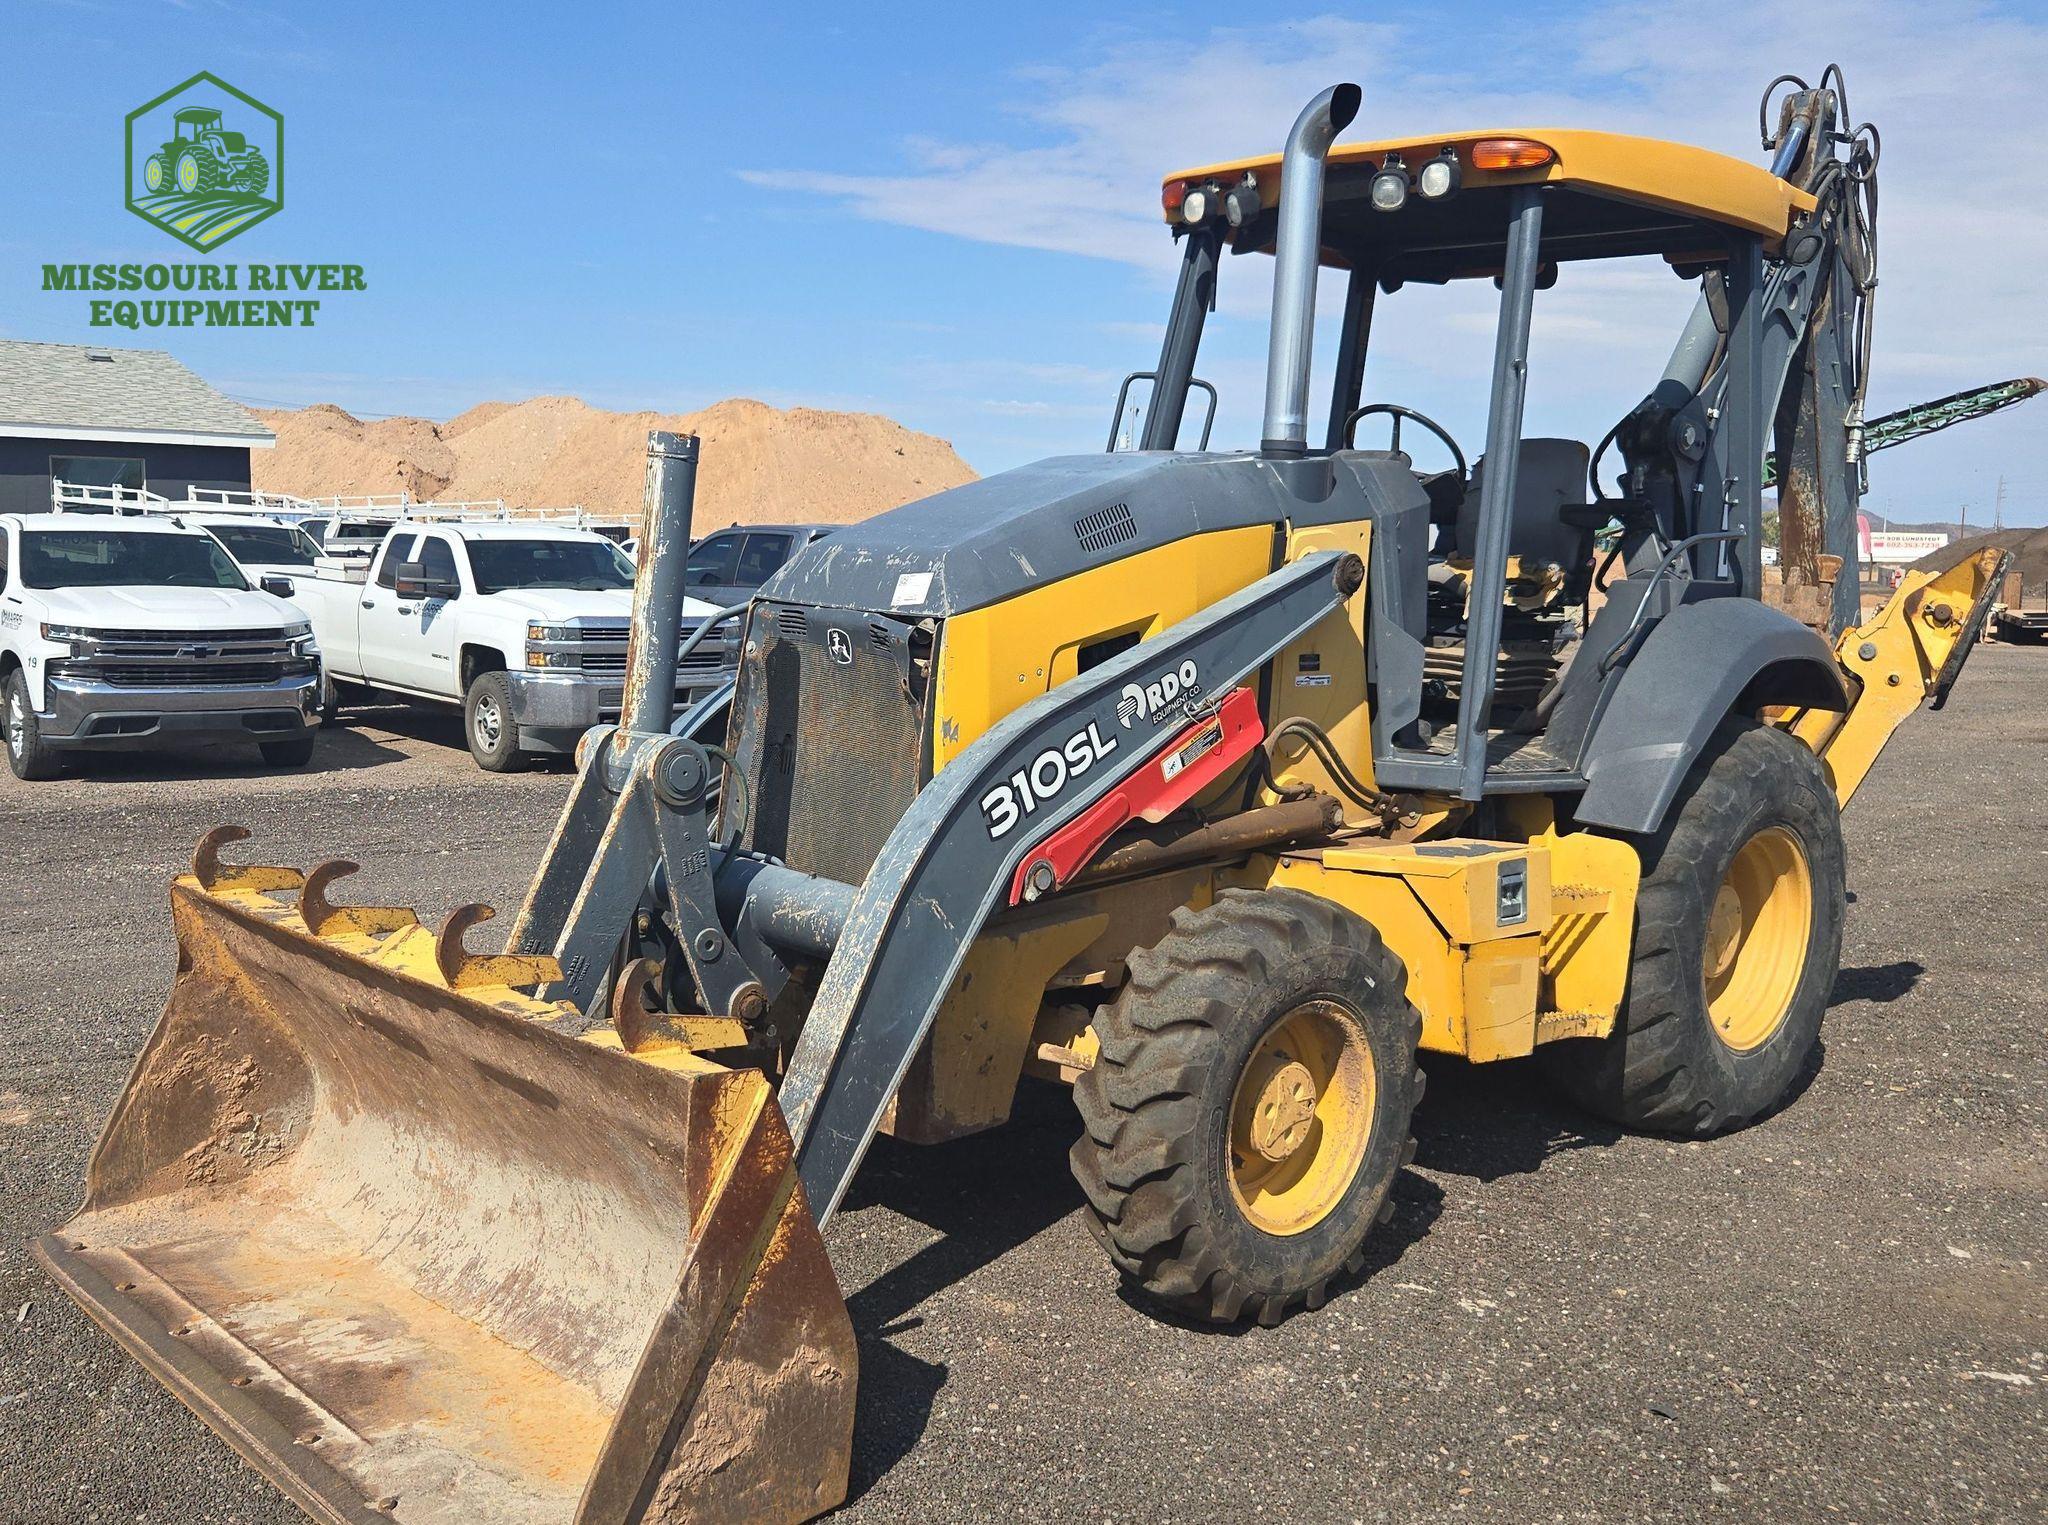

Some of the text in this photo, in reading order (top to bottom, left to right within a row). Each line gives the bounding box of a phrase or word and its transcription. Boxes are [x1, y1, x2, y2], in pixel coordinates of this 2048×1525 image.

[28, 657, 37, 668] 19
[1152, 685, 1202, 725] EQUIPMENT CO.
[980, 725, 1119, 840] 310SL
